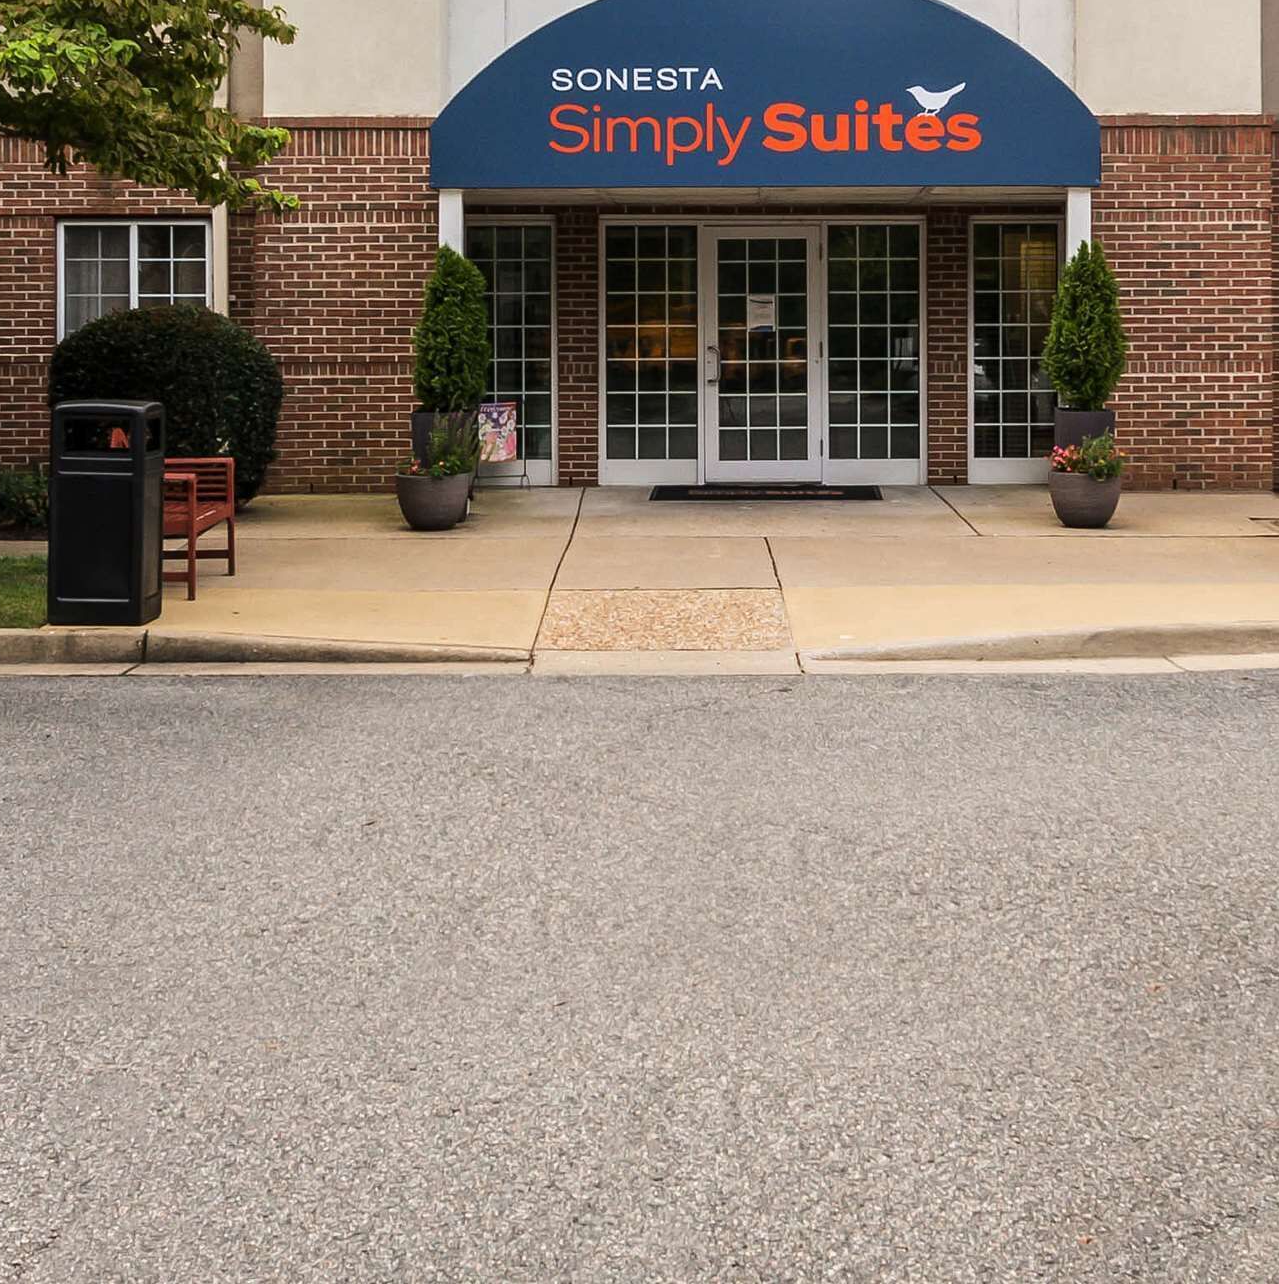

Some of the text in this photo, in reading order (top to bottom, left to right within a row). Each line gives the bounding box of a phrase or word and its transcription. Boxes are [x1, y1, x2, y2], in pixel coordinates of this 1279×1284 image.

[551, 67, 724, 92] SONESTA
[548, 99, 982, 166] Simply Suites
